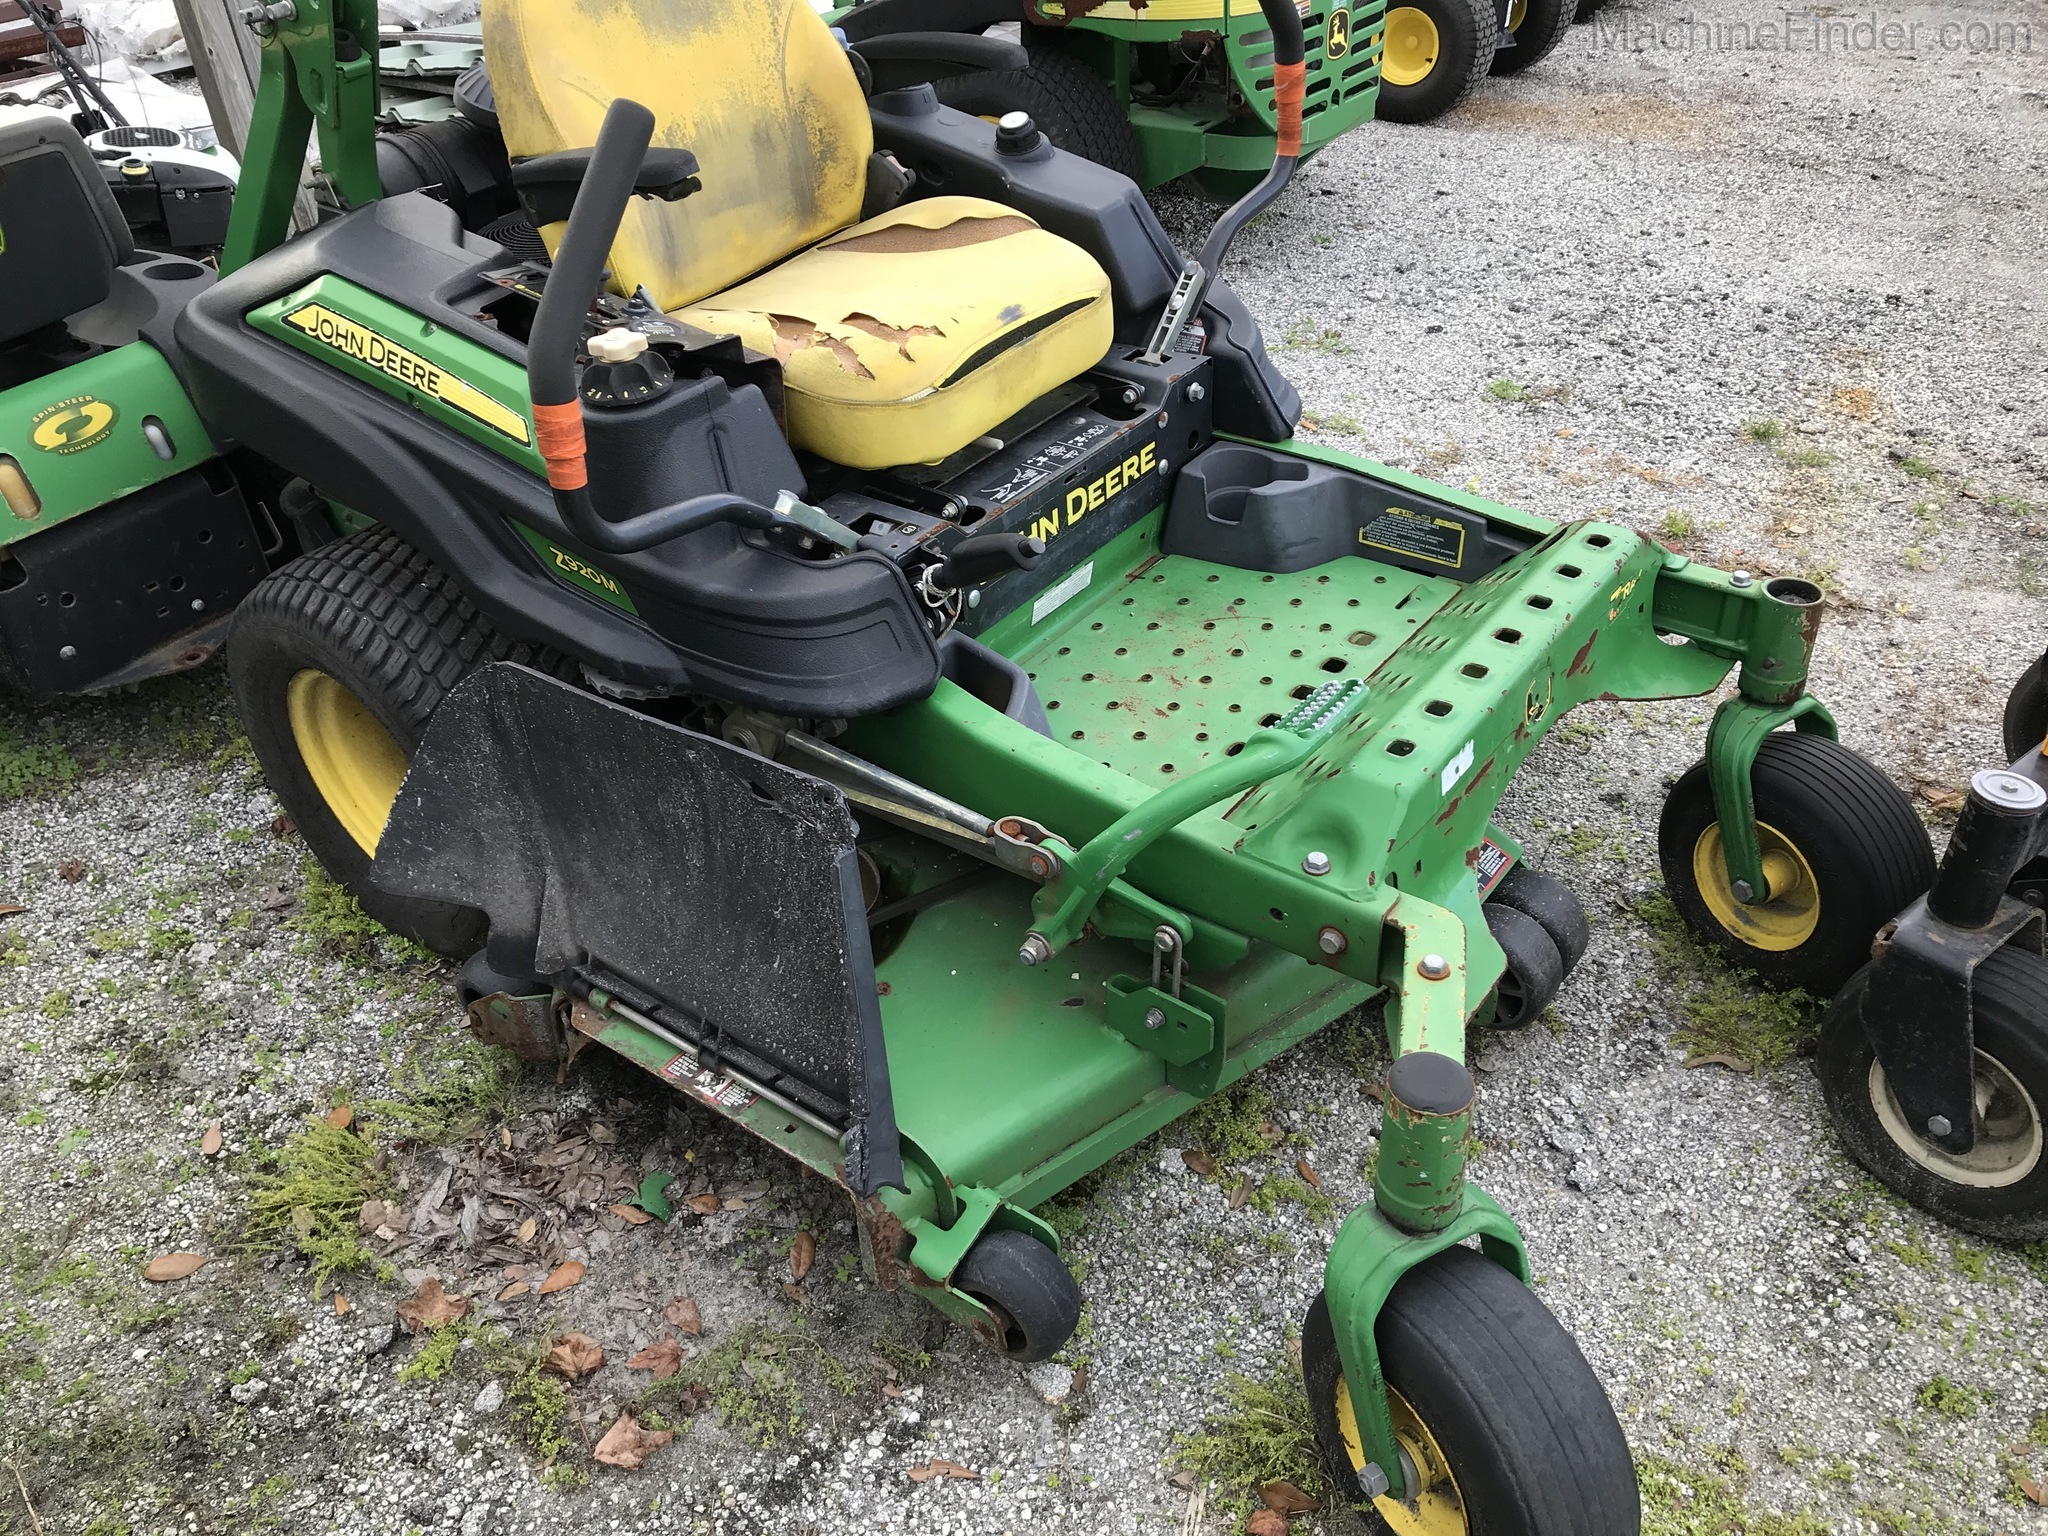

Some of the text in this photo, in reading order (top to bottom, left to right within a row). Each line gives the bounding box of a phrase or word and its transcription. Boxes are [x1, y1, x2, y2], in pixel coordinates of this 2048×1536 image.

[307, 310, 441, 395] JOHN DEERE
[32, 395, 94, 423] SPIN-STEER
[58, 430, 111, 454] TECHNOLOGY
[1066, 441, 1157, 527] DEERE
[549, 546, 620, 595] Z920M
